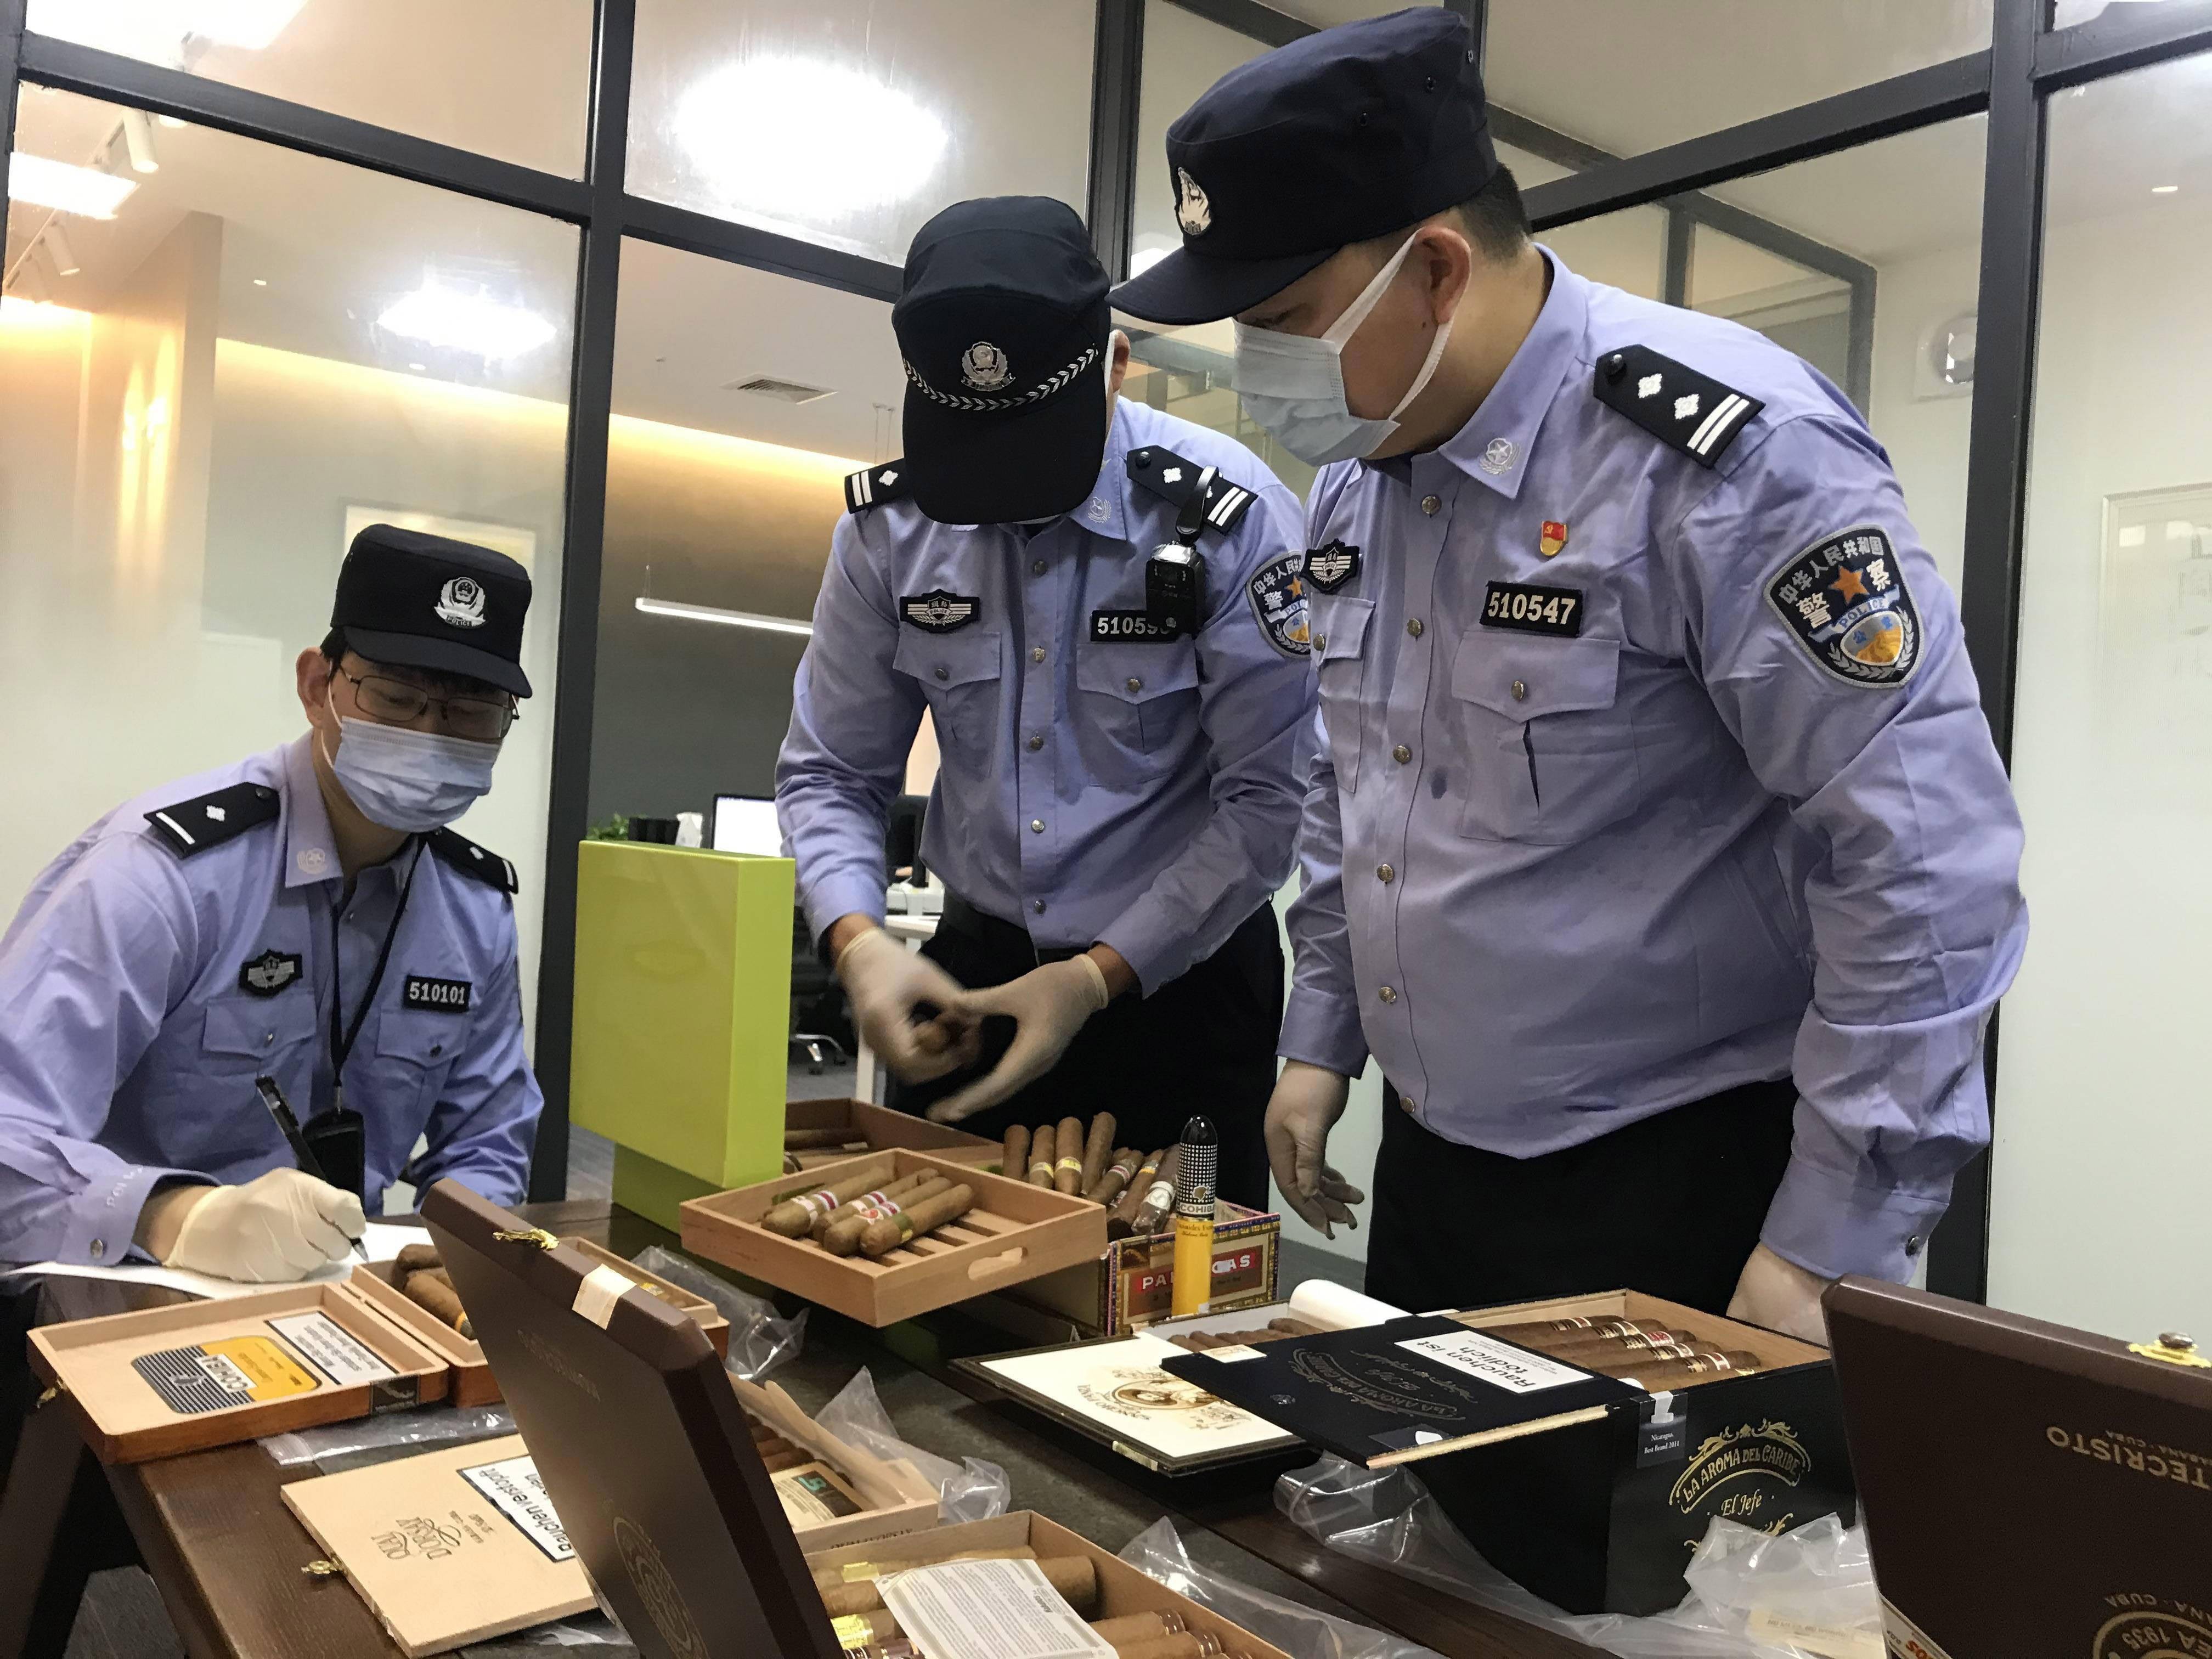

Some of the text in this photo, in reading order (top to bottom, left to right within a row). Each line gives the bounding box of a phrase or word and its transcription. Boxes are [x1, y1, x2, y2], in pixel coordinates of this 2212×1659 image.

[1779, 537, 1885, 604] 中华人民共和国
[1263, 591, 1283, 610] 警
[1796, 558, 1891, 629] 警 察
[447, 617, 470, 626] POLICE
[1488, 592, 1576, 625] 510547
[1839, 600, 1886, 628] POLICE
[409, 981, 465, 1005] 510101
[1417, 1341, 1445, 1352] ist
[1447, 1352, 1536, 1387] Rauchen
[1460, 1347, 1527, 1374] tödlich
[1655, 1442, 1668, 1452] Brand
[2106, 1430, 2146, 1447] CUBA
[2046, 1426, 2212, 1491] TECRISTO
[1683, 1444, 1801, 1503] LA AROMA DEL CARIBE
[1721, 1488, 1762, 1516] El Jefe
[2104, 1593, 2157, 1607] CUBA
[2122, 1626, 2170, 1650] 1935
